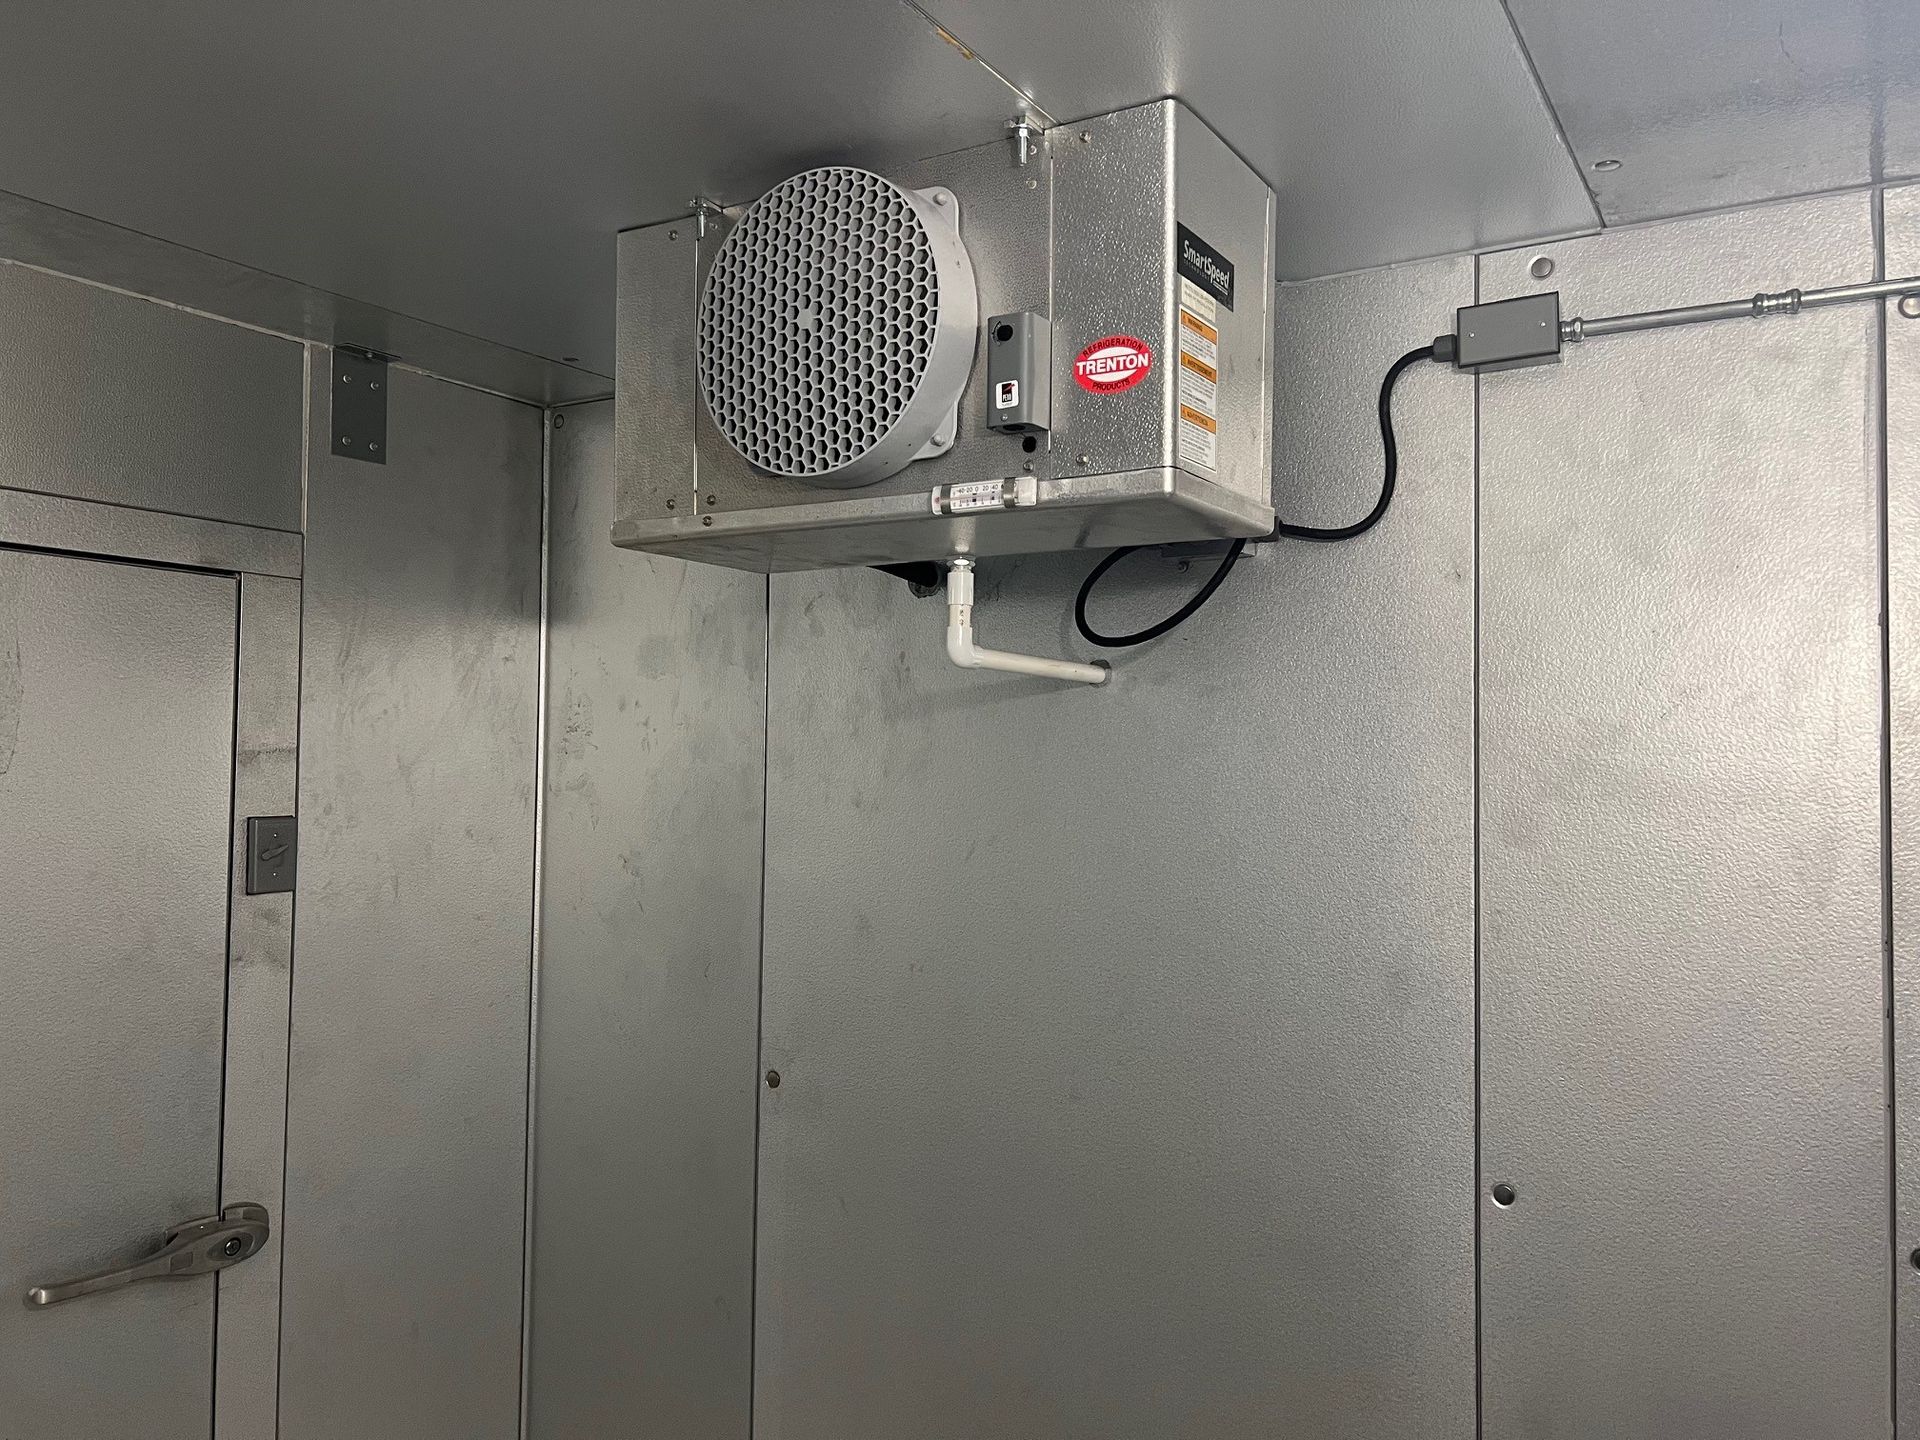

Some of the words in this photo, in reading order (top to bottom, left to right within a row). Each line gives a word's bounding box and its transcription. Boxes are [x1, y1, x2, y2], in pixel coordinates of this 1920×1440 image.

[1183, 240, 1229, 290] SmartSpeed
[1083, 338, 1143, 356] REFRIGERATION
[1076, 353, 1149, 376] TRENTON
[1092, 378, 1131, 391] PRODUCTS
